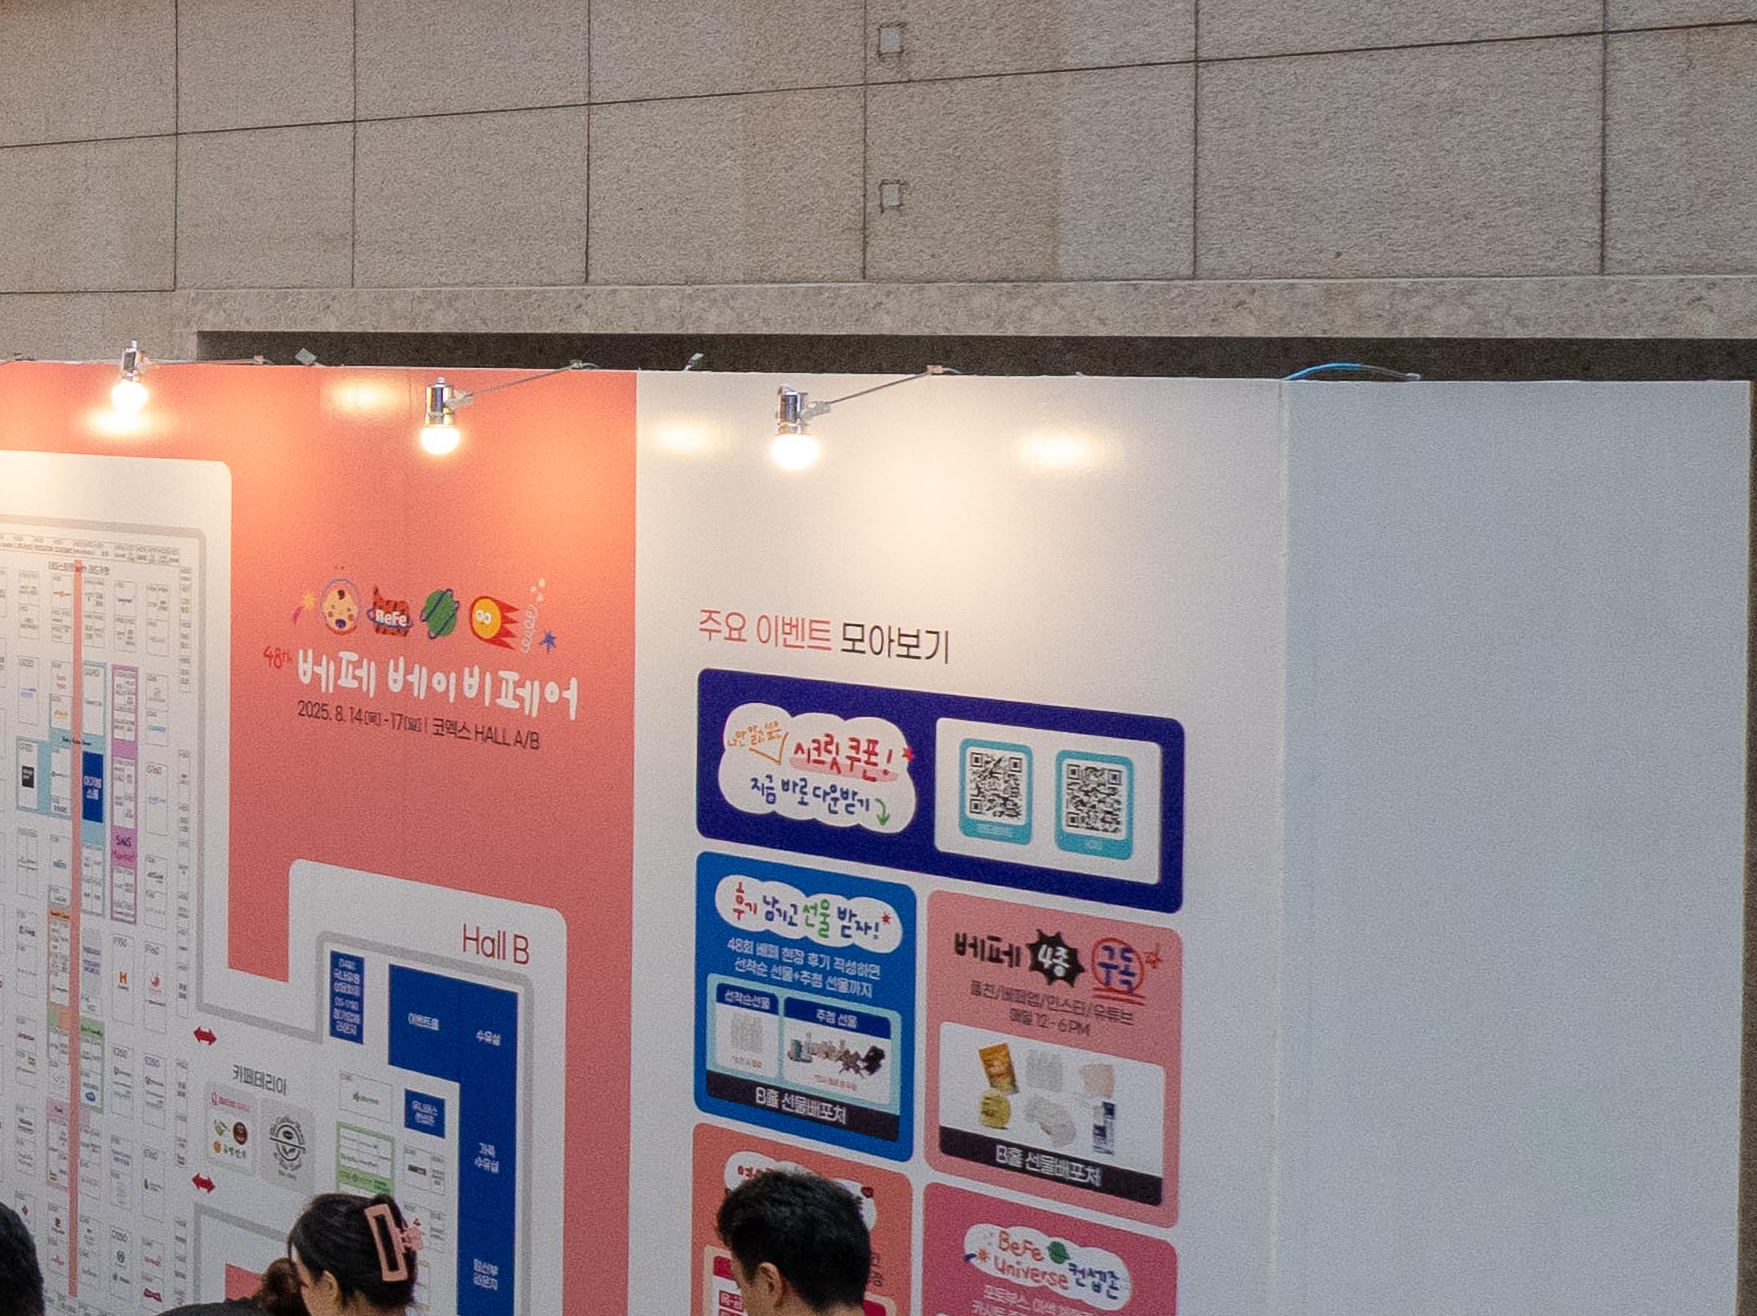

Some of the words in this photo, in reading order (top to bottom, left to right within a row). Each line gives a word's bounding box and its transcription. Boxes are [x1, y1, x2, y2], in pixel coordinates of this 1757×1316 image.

[376, 609, 407, 626] BeFe
[699, 609, 747, 643] 주요
[756, 614, 832, 651] 이벤트
[841, 622, 949, 664] 모아보기
[263, 647, 292, 669] 48th
[298, 649, 376, 698] 베페
[388, 656, 578, 720] 베이비페어
[298, 700, 332, 721] 2025.
[475, 724, 511, 747] HALL
[513, 730, 539, 750] A/B
[794, 733, 841, 774] 시크릿
[750, 774, 776, 804] 지금
[781, 777, 808, 806] 바로
[812, 785, 870, 815] 다운받기
[733, 881, 757, 920] 후기
[763, 895, 798, 927] 남기고
[802, 898, 831, 939] 선물
[837, 906, 880, 940] 받자!
[462, 924, 506, 960] Hall
[513, 934, 530, 965] B
[808, 952, 831, 971] 후기
[954, 932, 1021, 968] 베페
[1037, 943, 1073, 978] 4종
[1098, 944, 1136, 995] 구독
[781, 1091, 846, 1125] 선물배포처
[1025, 1148, 1102, 1186] 선물배포처
[999, 1230, 1044, 1262] BeFe
[993, 1254, 1069, 1290] Universe
